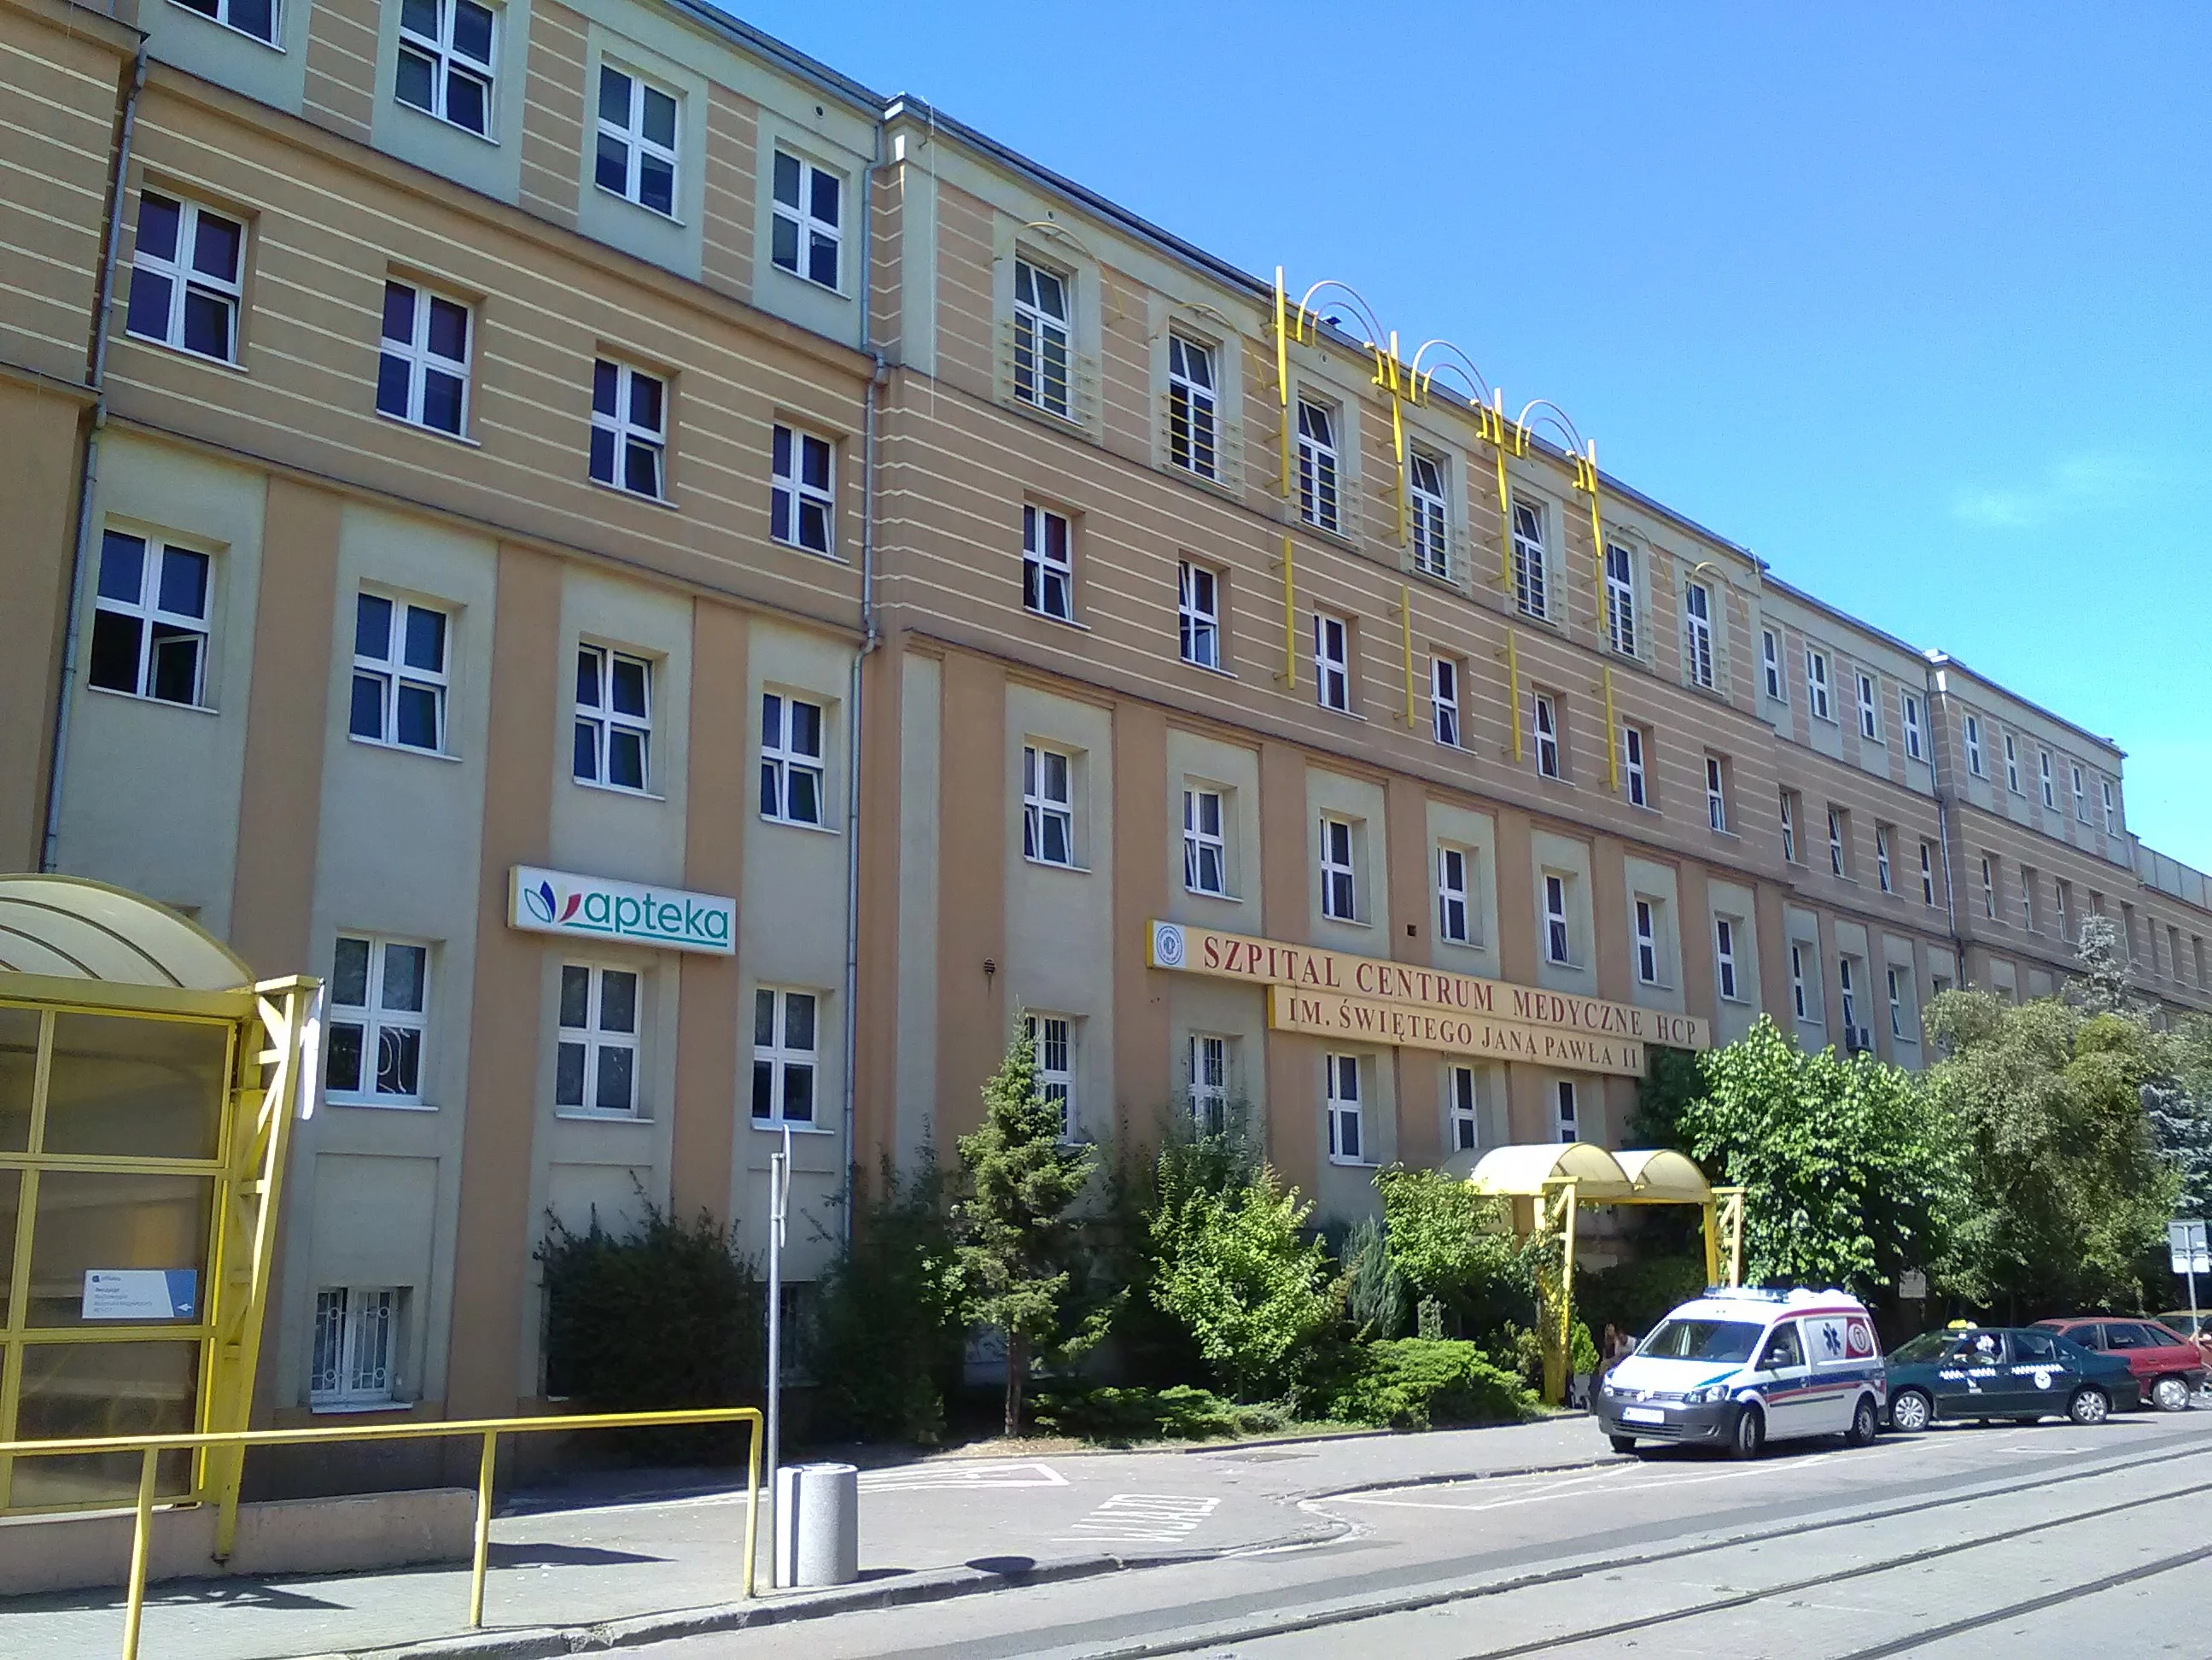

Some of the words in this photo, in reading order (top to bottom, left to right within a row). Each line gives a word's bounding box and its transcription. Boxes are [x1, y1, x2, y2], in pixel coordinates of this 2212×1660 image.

[584, 892, 728, 939] apteka
[1204, 936, 1340, 988] SZPITAL
[1356, 962, 1493, 1012] CENTRUM
[1512, 989, 1643, 1036] MEDYCZNE
[1656, 1014, 1696, 1044] HCP
[1289, 997, 1330, 1026] IM.
[1339, 998, 1472, 1045] ŚWIĘTEGO
[1481, 1026, 1537, 1055] JANA
[1545, 1036, 1613, 1066] PAWŁA
[1623, 1048, 1637, 1068] II
[1049, 1493, 1222, 1542] WJAZD
